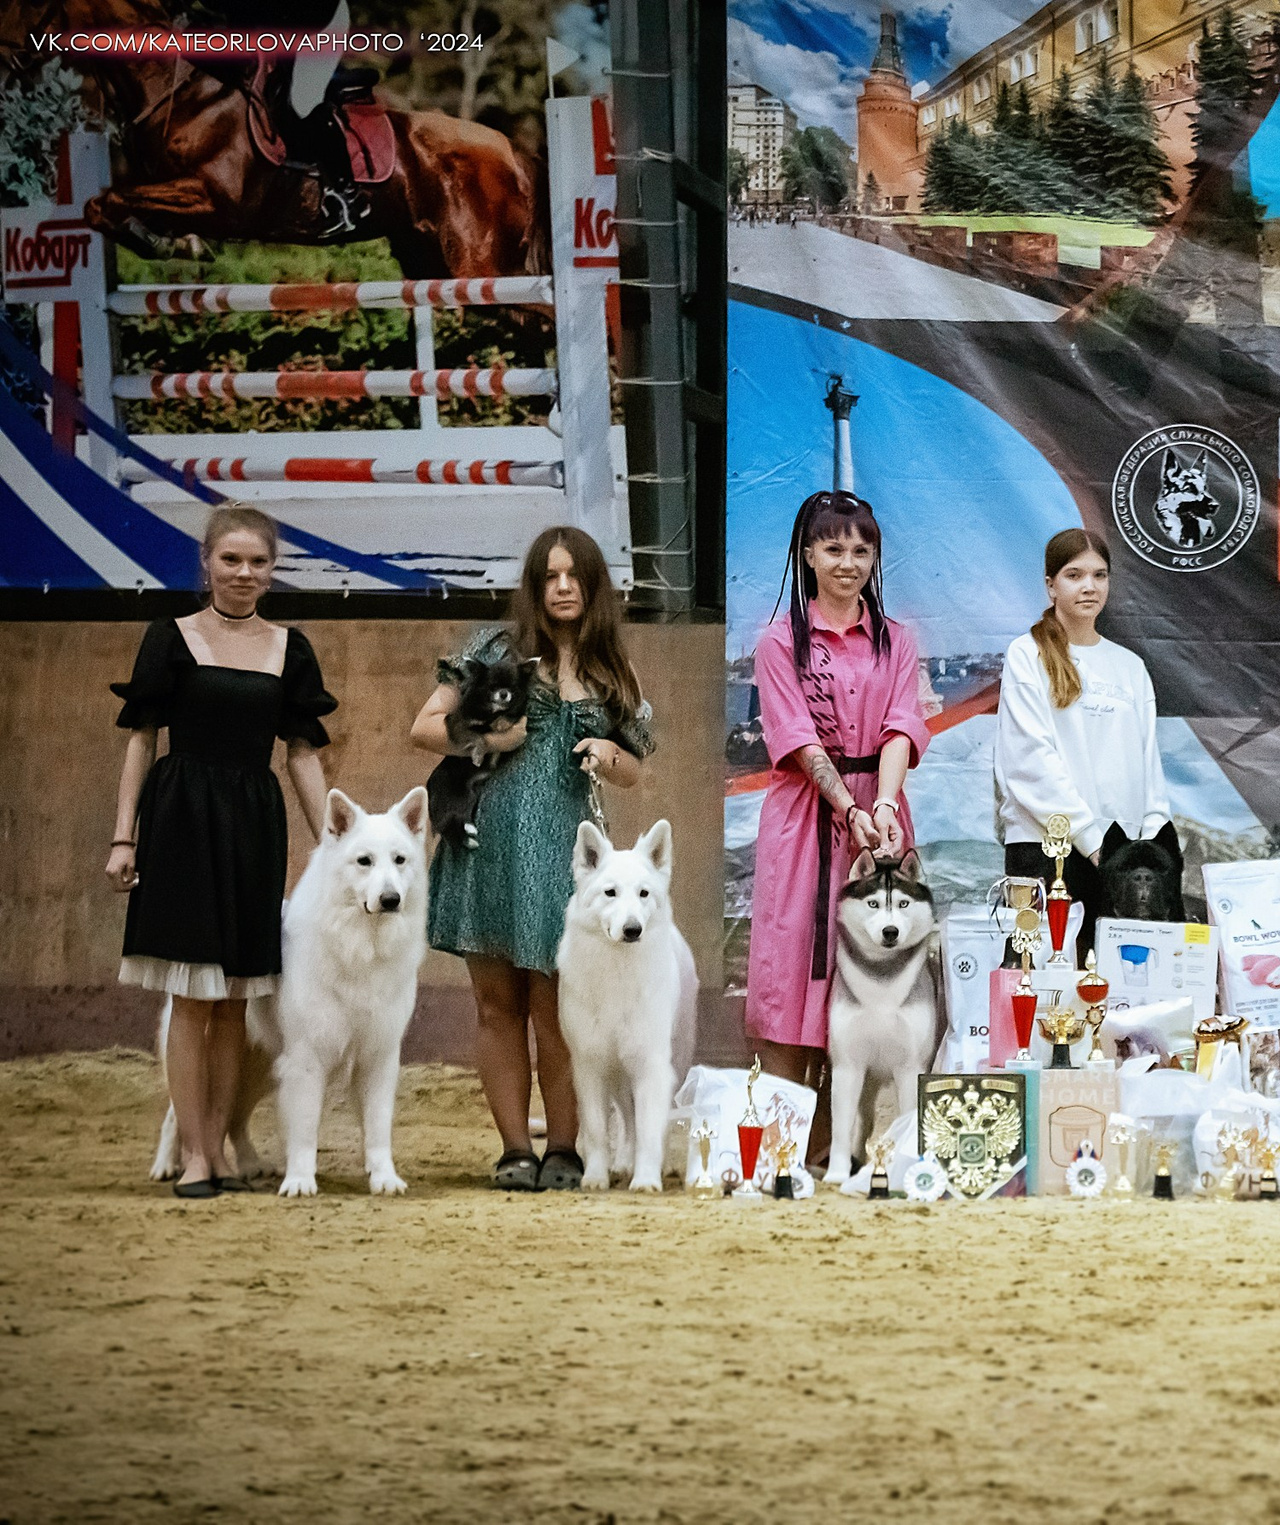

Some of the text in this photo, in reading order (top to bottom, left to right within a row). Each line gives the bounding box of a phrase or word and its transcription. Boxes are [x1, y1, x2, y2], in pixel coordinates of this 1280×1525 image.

[4, 220, 92, 288] Кобарт
[1120, 433, 1170, 483] ФЕДЕРАЦИЯ
[1169, 430, 1241, 463] СЛУЖЕБНОГО
[1232, 932, 1260, 944] BOWL
